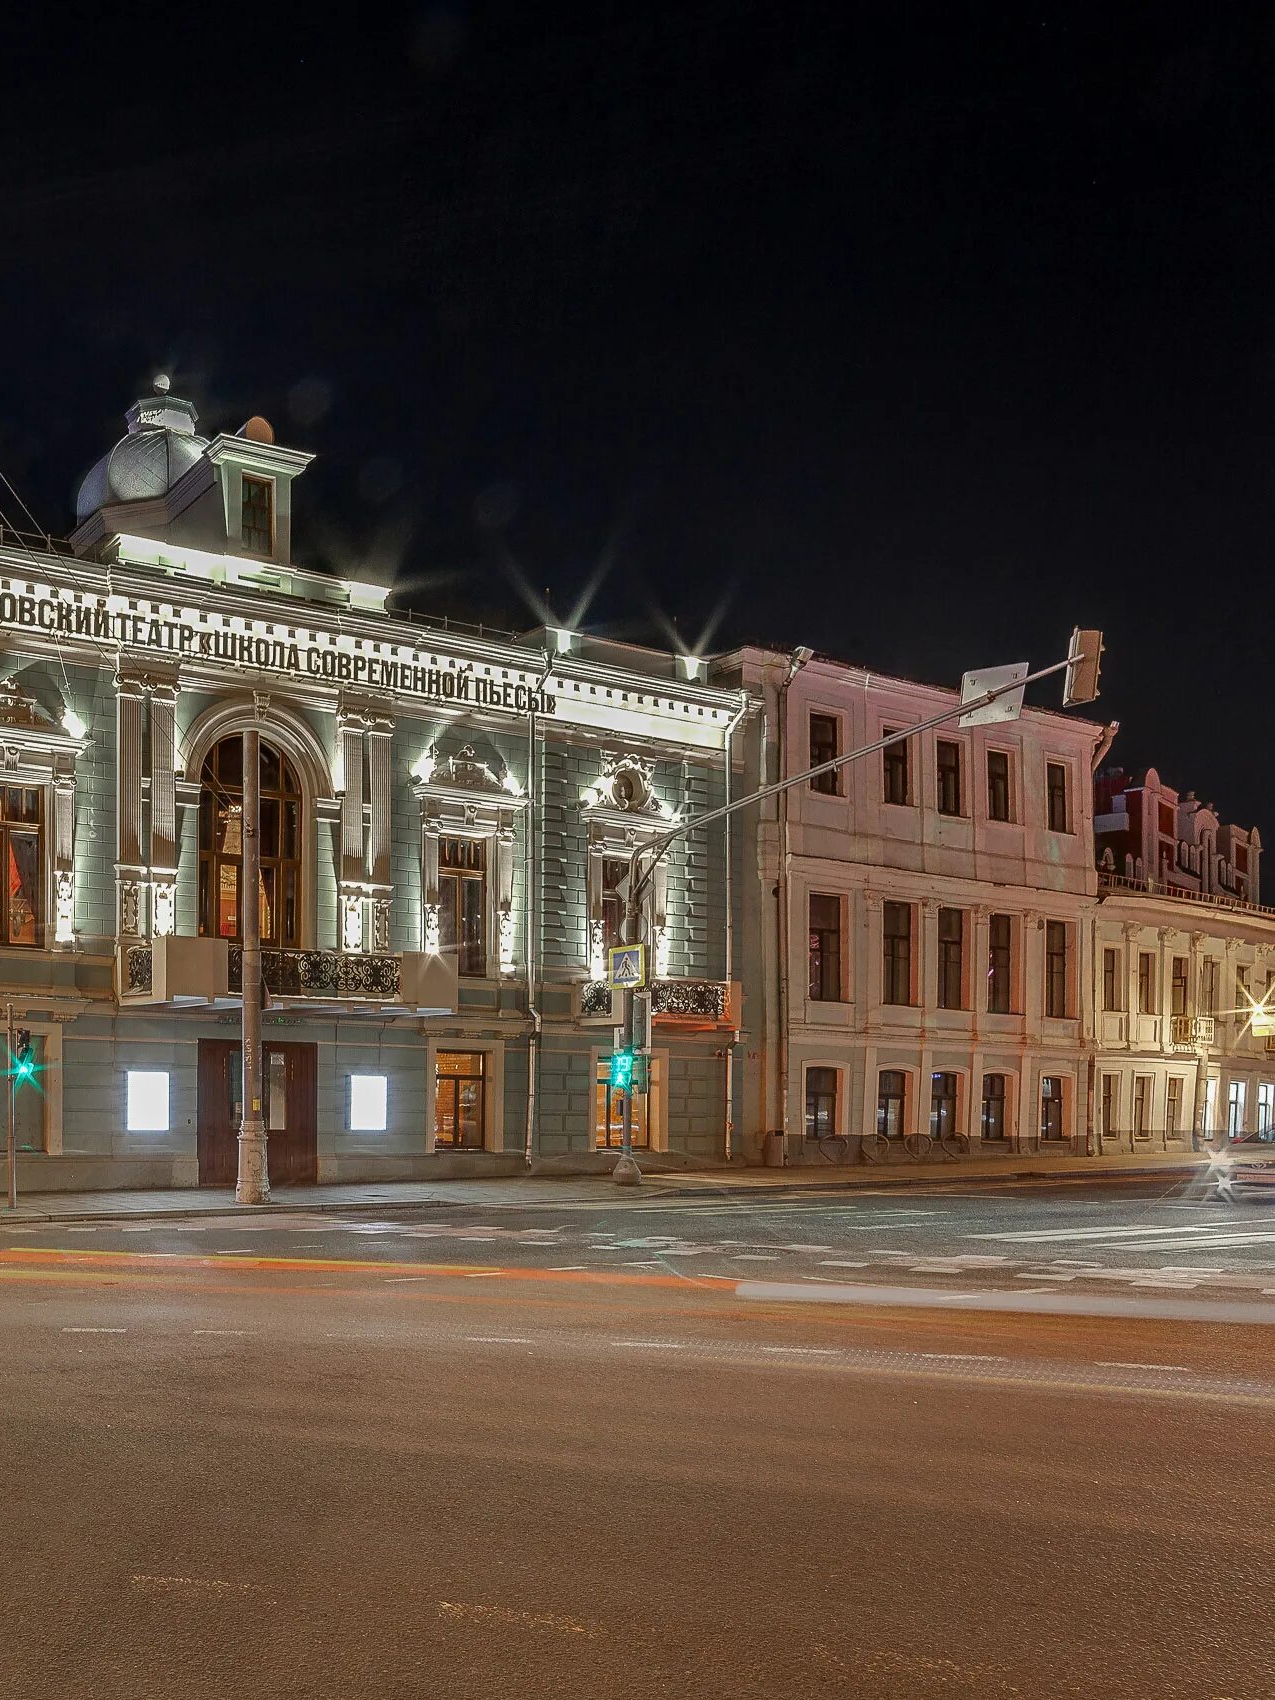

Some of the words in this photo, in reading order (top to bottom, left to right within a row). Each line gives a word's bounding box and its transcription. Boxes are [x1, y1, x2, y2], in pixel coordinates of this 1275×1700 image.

[116, 612, 194, 651] ТЕАТР
[199, 630, 301, 672] «ШКОЛА
[306, 646, 469, 701] СОВРЕМЕННОЙ
[475, 677, 557, 715] ПЬЕСЫ»
